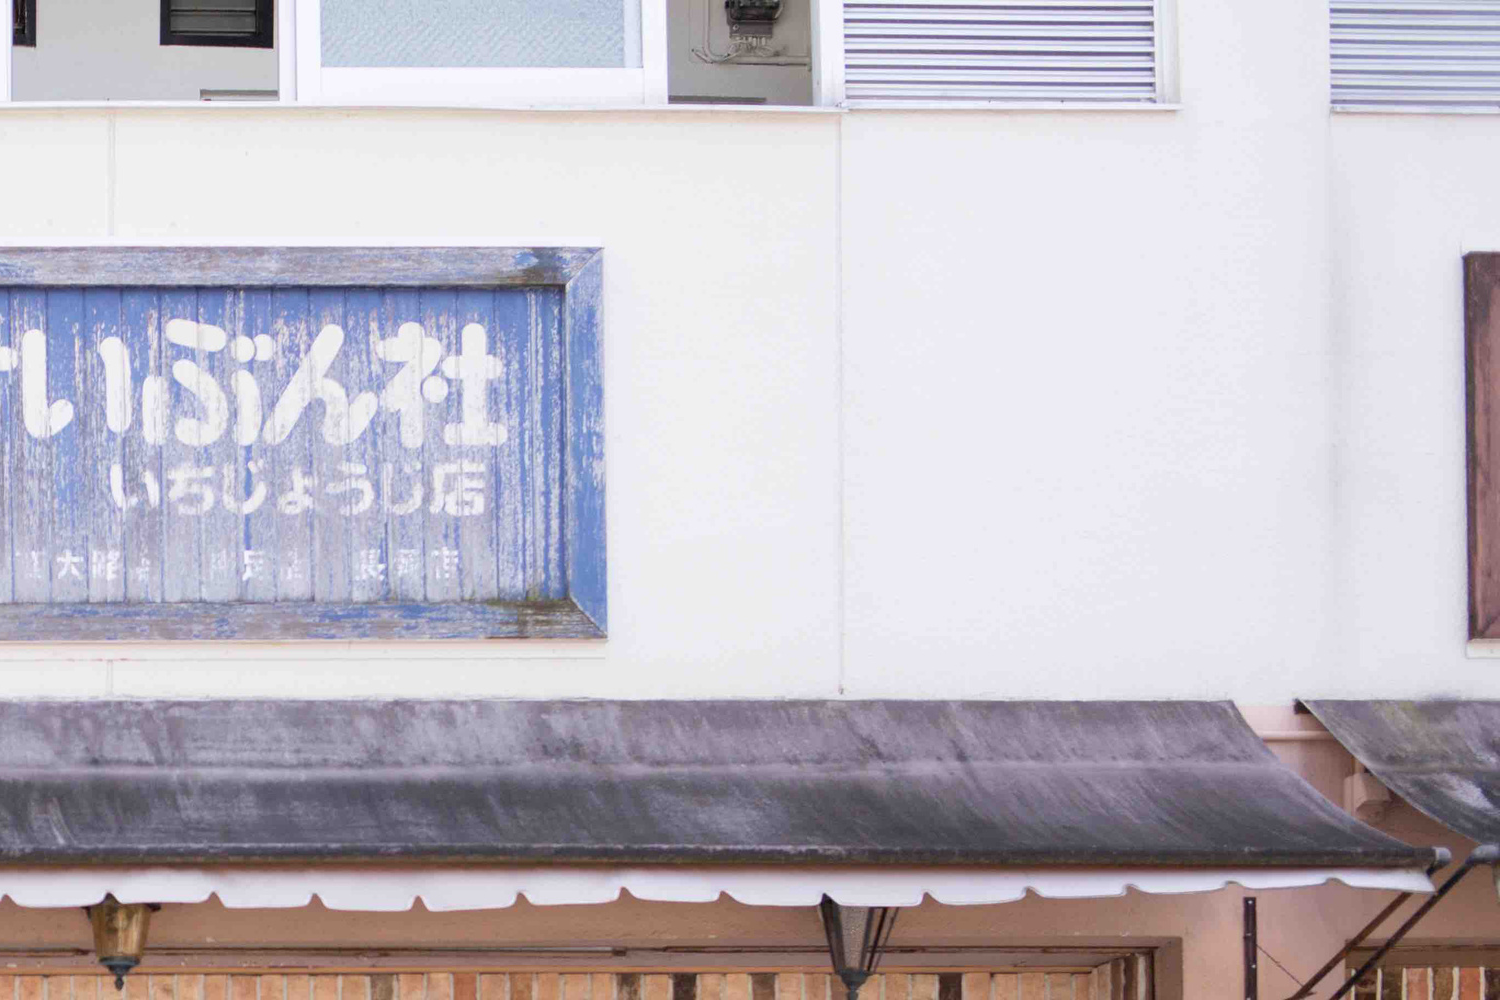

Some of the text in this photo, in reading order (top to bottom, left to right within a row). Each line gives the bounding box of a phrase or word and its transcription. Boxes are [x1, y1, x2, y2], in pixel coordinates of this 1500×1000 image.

[109, 461, 487, 517] いちじょうじ店
